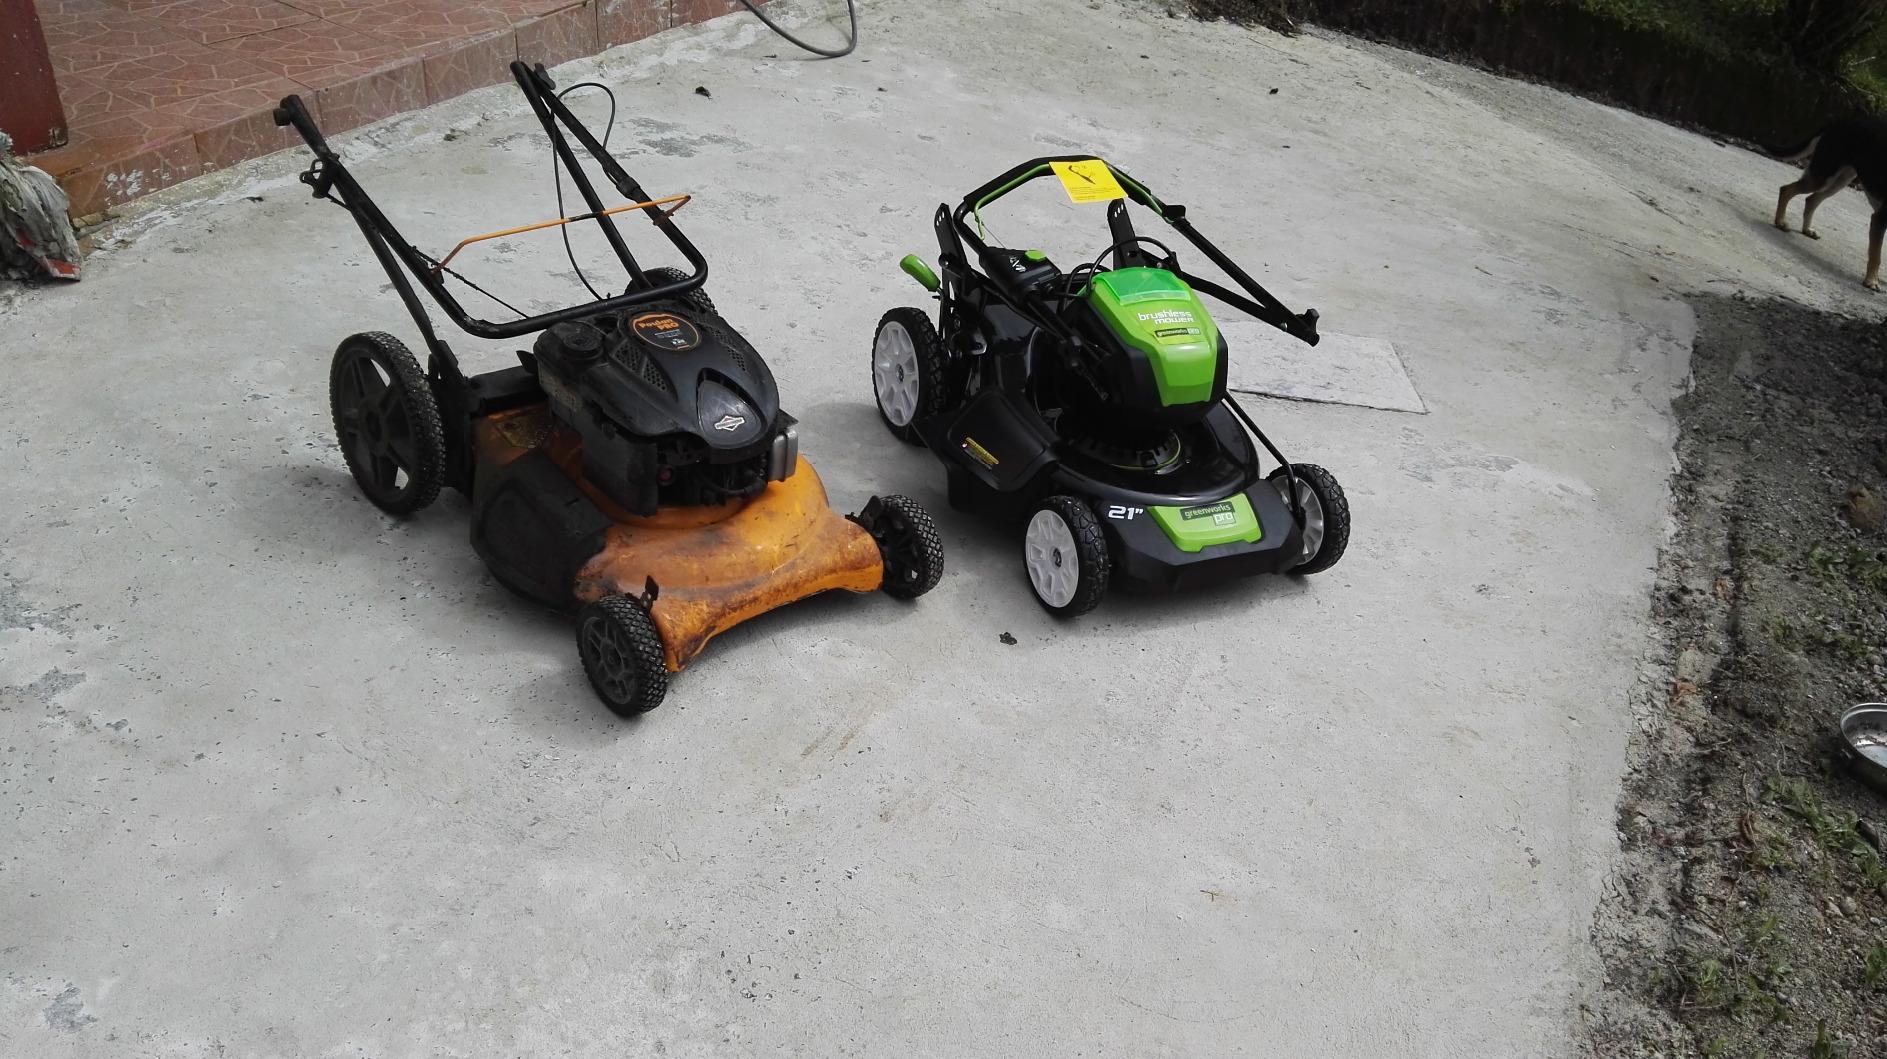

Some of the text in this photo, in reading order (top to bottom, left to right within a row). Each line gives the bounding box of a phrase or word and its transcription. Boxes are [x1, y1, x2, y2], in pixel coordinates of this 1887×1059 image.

[1138, 310, 1192, 320] brushless
[1184, 503, 1232, 519] greenworks
[1215, 512, 1233, 524] pro
